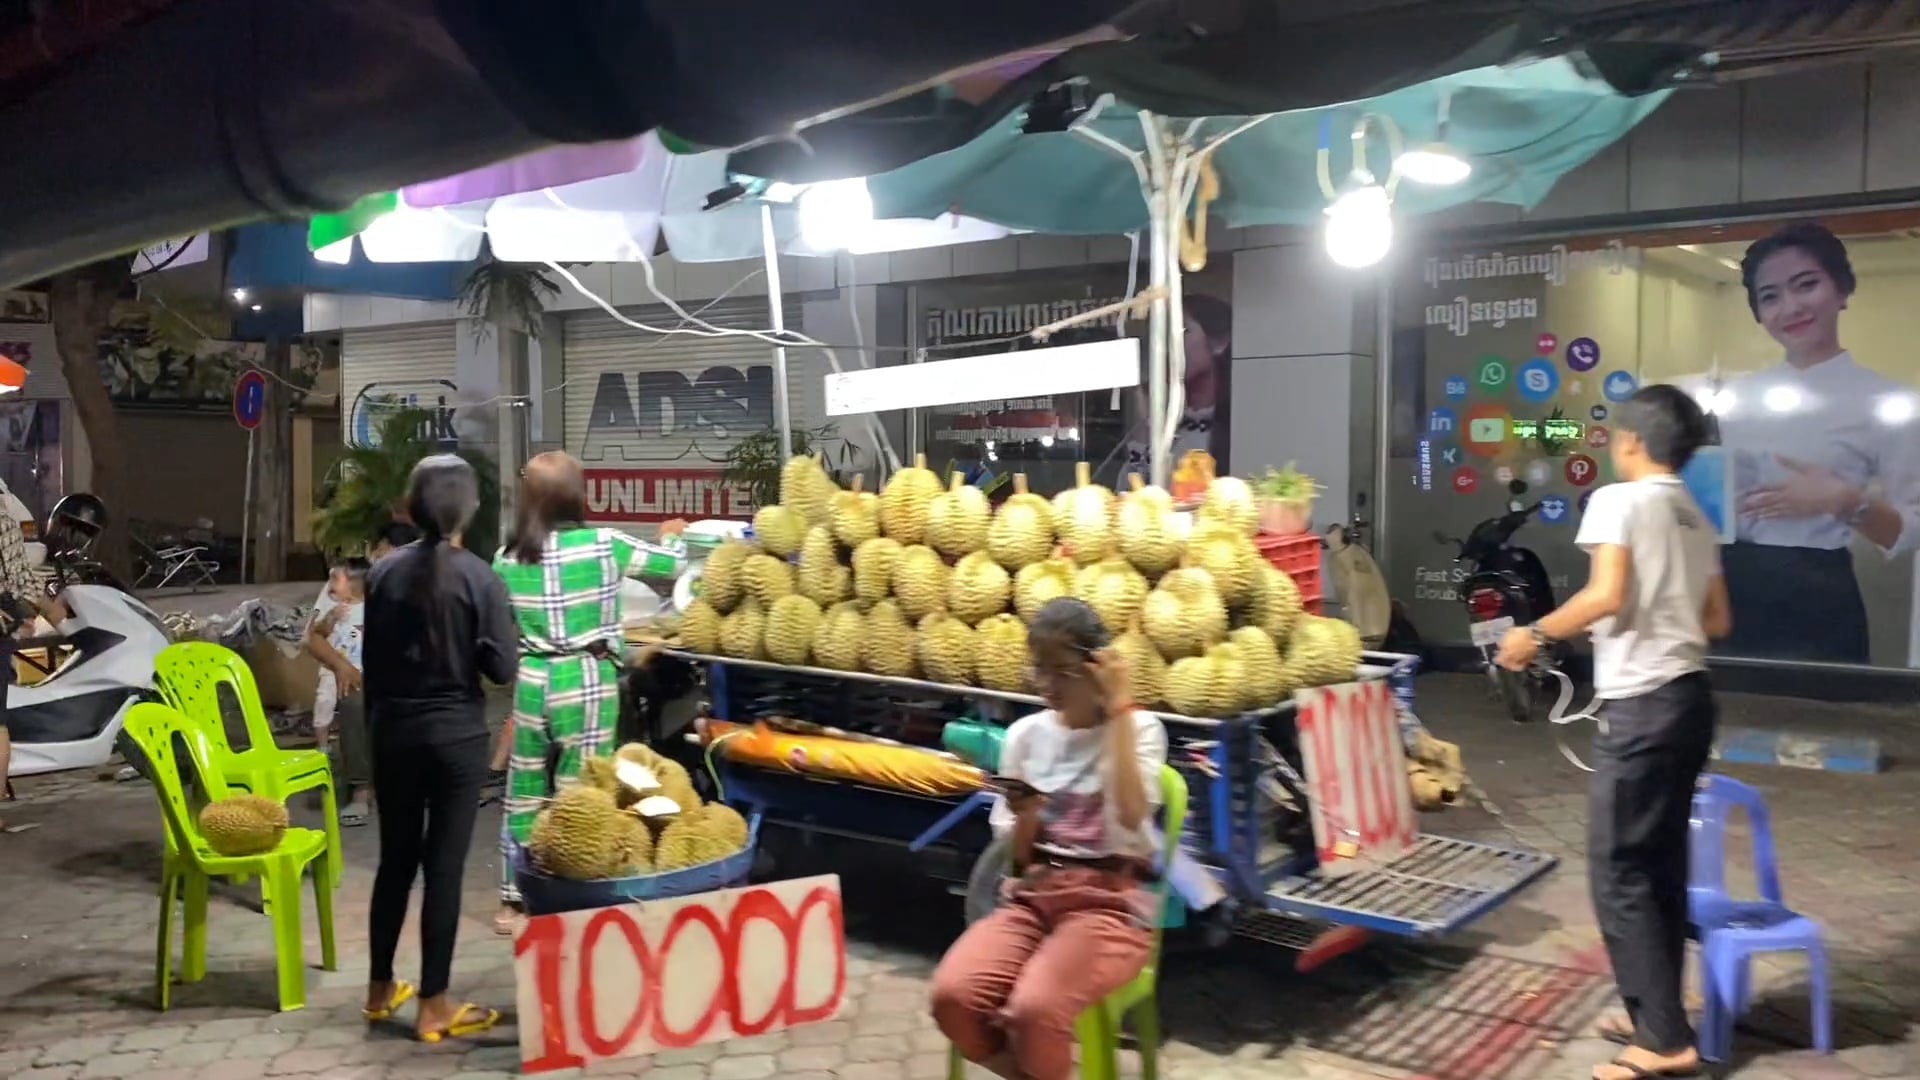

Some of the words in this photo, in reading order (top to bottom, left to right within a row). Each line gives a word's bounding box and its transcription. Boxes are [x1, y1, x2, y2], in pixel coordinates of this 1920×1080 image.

[1430, 411, 1452, 431] in
[586, 477, 764, 515] UNLIMITE
[514, 885, 847, 1073] 10000
